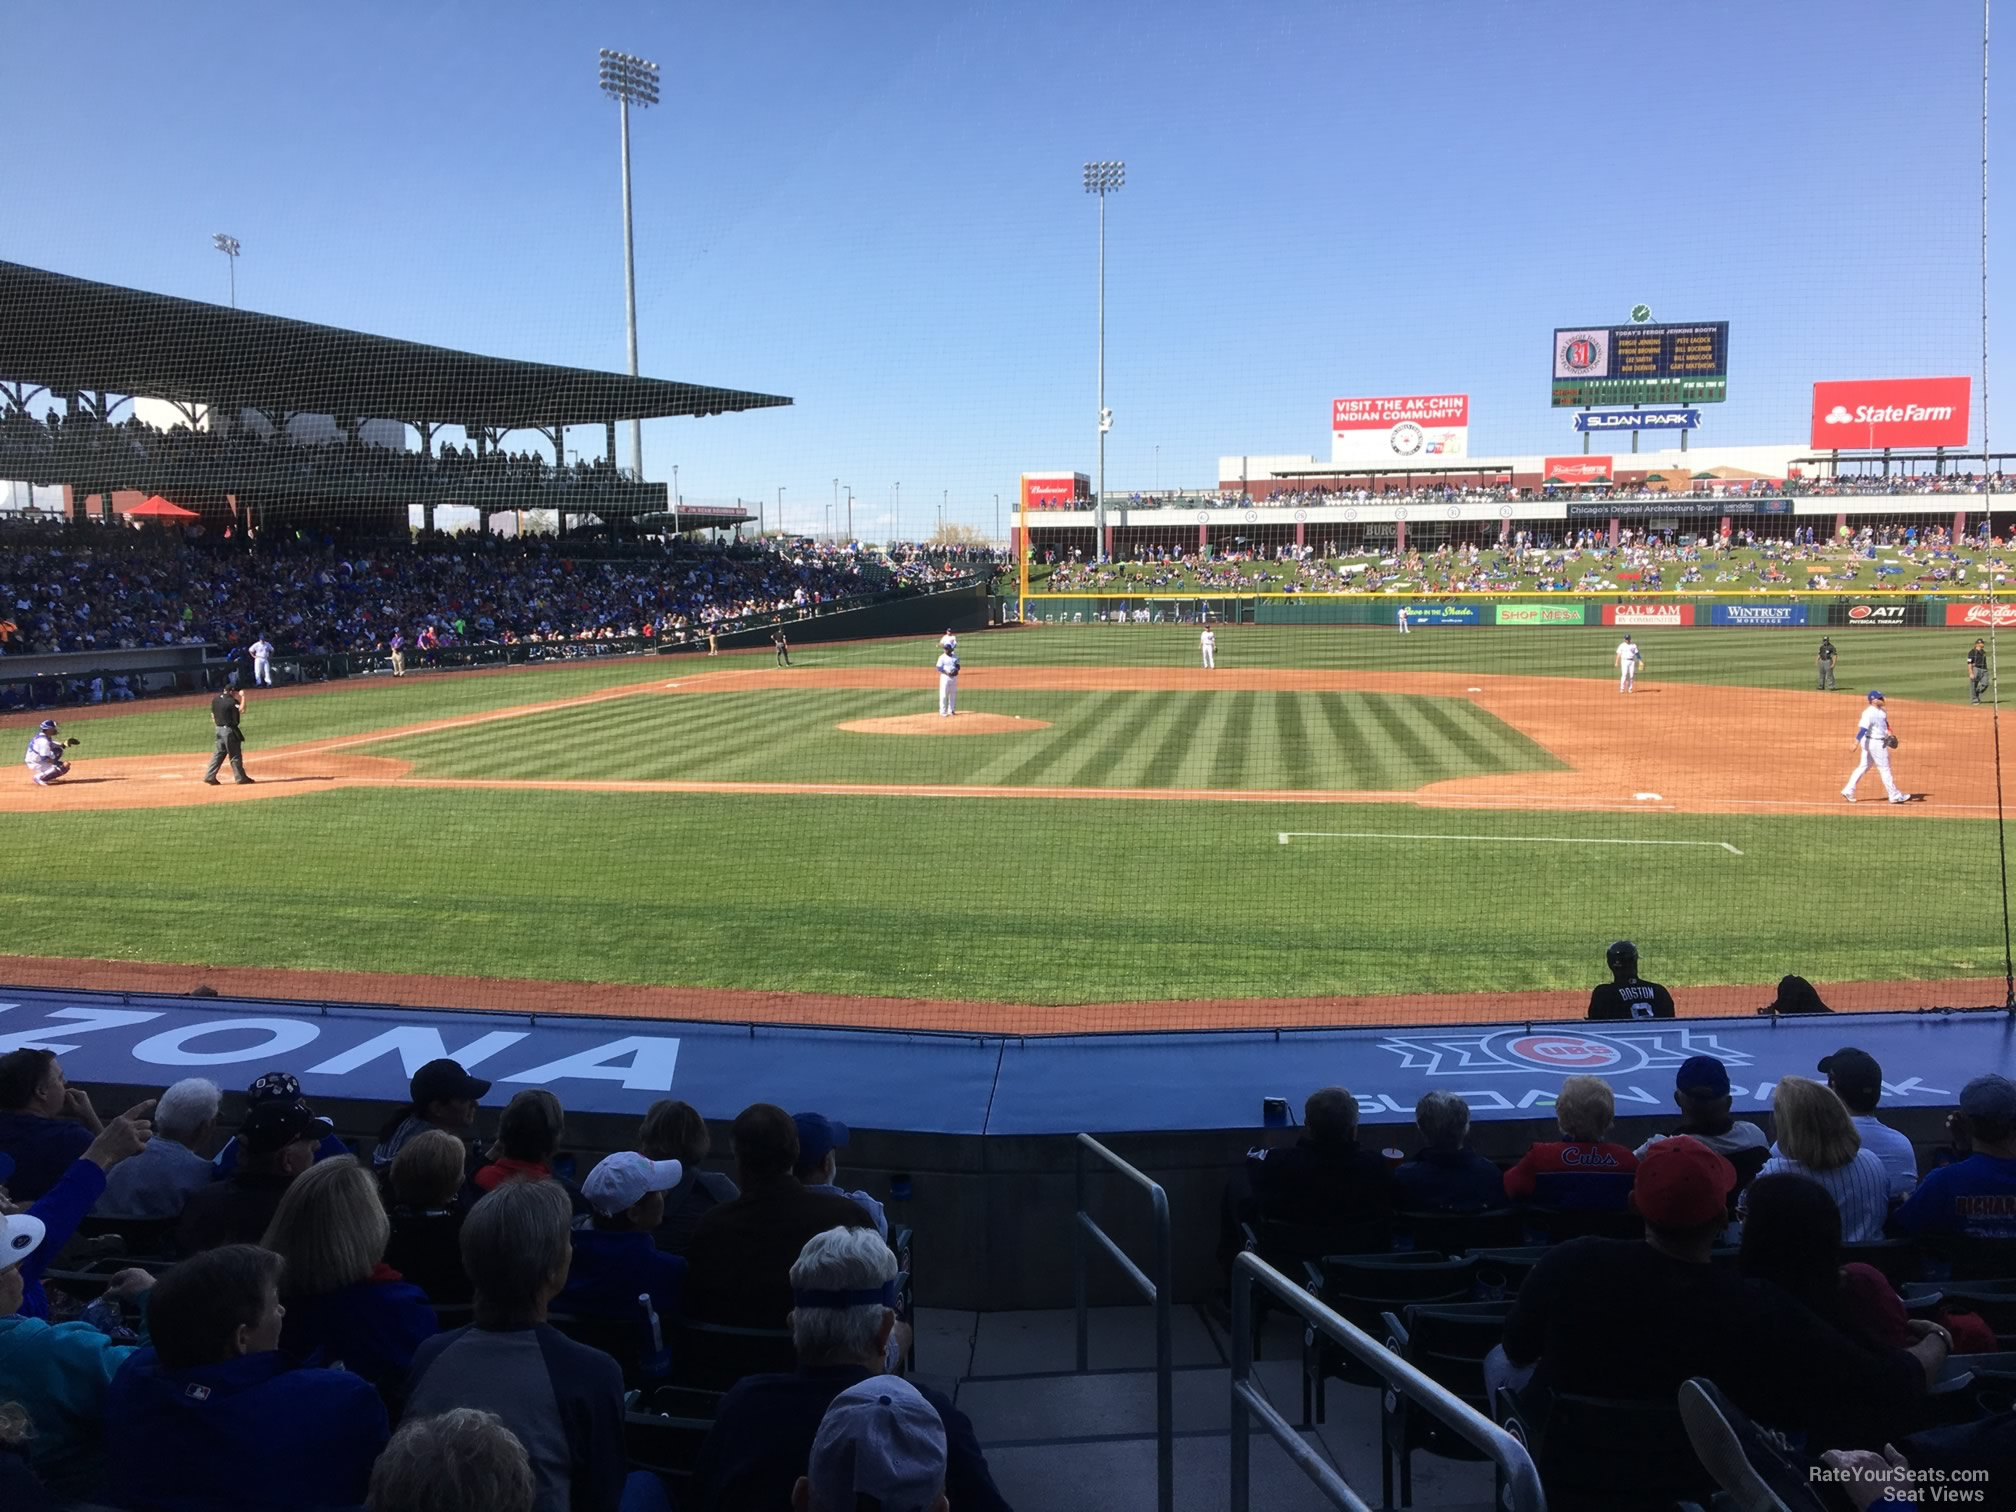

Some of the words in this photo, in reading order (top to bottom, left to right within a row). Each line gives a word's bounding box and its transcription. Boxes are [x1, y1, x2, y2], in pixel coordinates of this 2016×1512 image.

[1572, 341, 1589, 366] 31
[1336, 401, 1372, 412] VISIT
[1376, 399, 1403, 411] THE
[1406, 397, 1463, 410] AK-CHIN
[1336, 411, 1380, 422] INDIAN
[1382, 408, 1463, 420] COMMUNITY
[1587, 416, 1641, 427] SLOAN
[1645, 414, 1688, 424] PARK
[1030, 485, 1069, 494] Budweiser
[1570, 506, 1609, 515] Chicago's
[1610, 505, 1642, 515] Original
[1643, 503, 1695, 513] Architecture
[1366, 524, 1412, 536] BURGR
[1501, 610, 1538, 620] SHOP
[1542, 609, 1582, 620] MESA
[1615, 605, 1645, 615] CAL
[1656, 605, 1680, 615] AM
[1870, 607, 1906, 617] ATI
[1619, 986, 1654, 1001] BOSTON
[1561, 1146, 1619, 1166] Cubs
